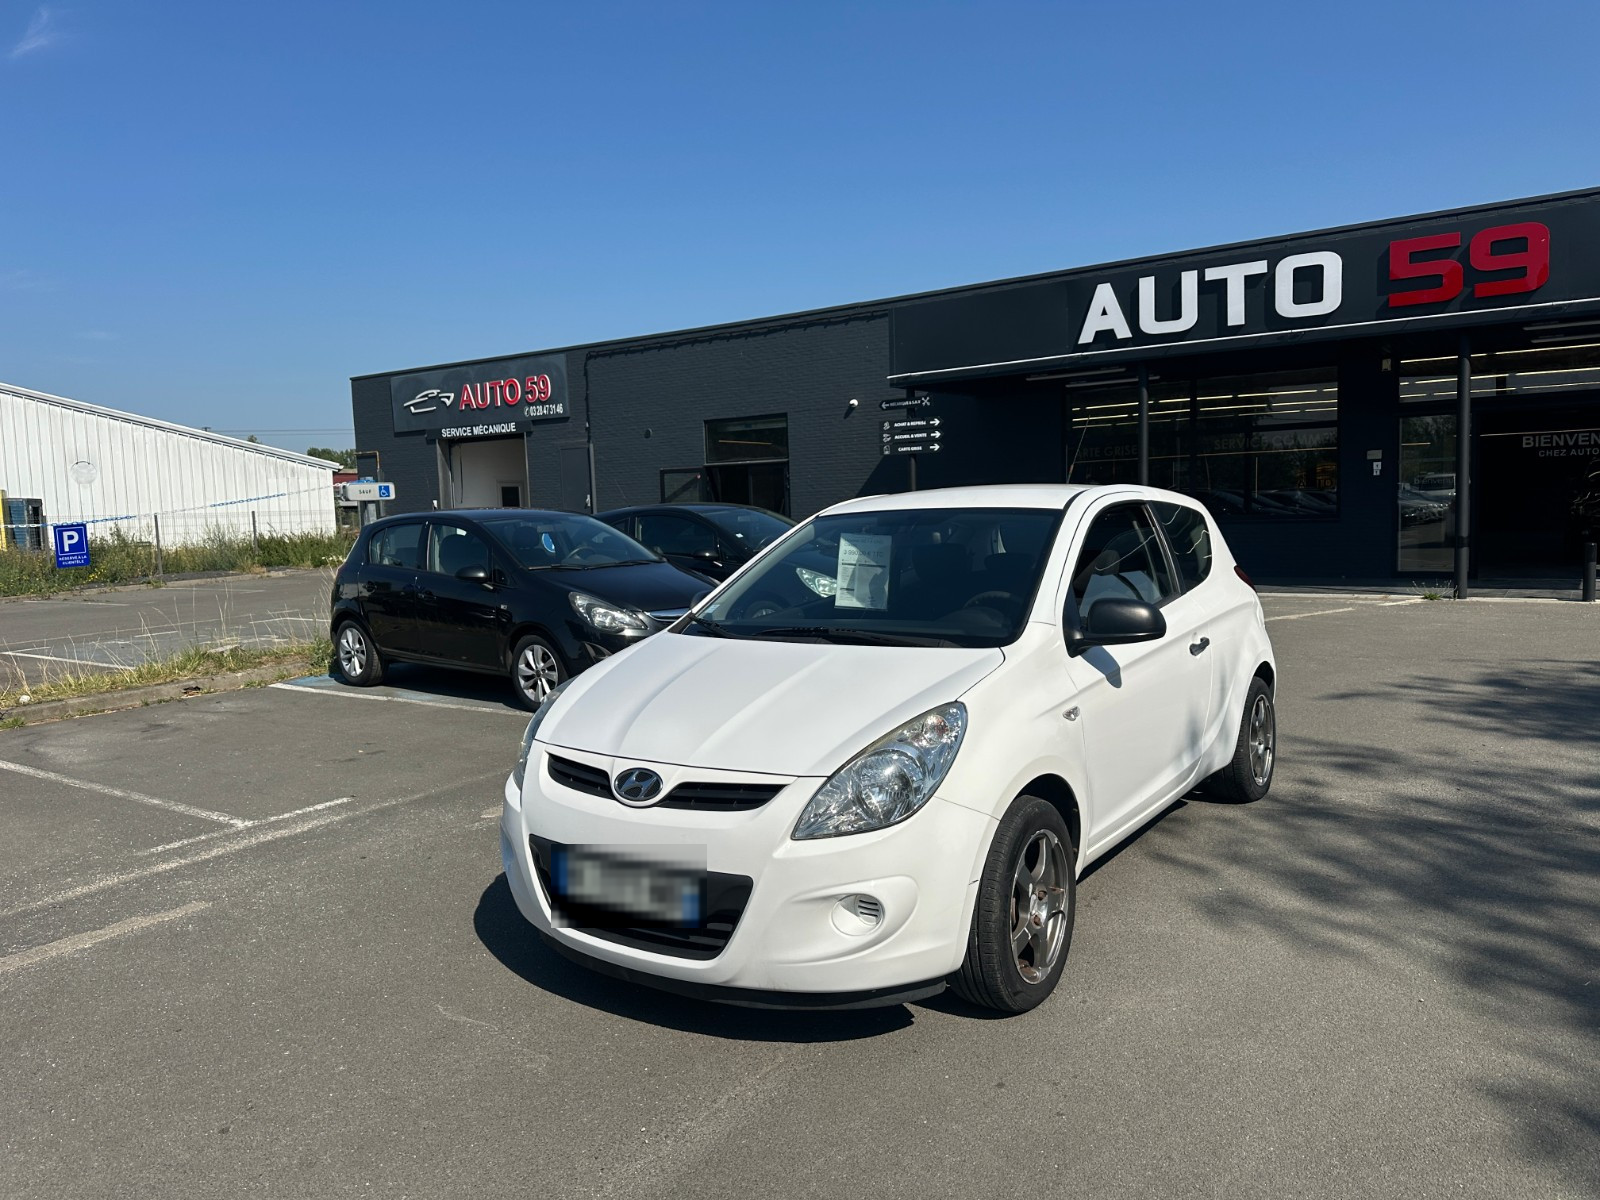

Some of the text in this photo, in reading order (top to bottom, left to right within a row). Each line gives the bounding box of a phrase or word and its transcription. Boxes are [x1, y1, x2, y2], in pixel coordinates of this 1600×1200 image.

[1078, 221, 1551, 344] AUTO 59
[458, 374, 552, 411] AUTO 59
[441, 422, 516, 438] SERVICE MÉCANIQUE
[1103, 443, 1139, 457] GRISE
[1214, 435, 1269, 450] SERVICE
[1538, 447, 1600, 457] CHEZ AUTO
[62, 530, 79, 552] P
